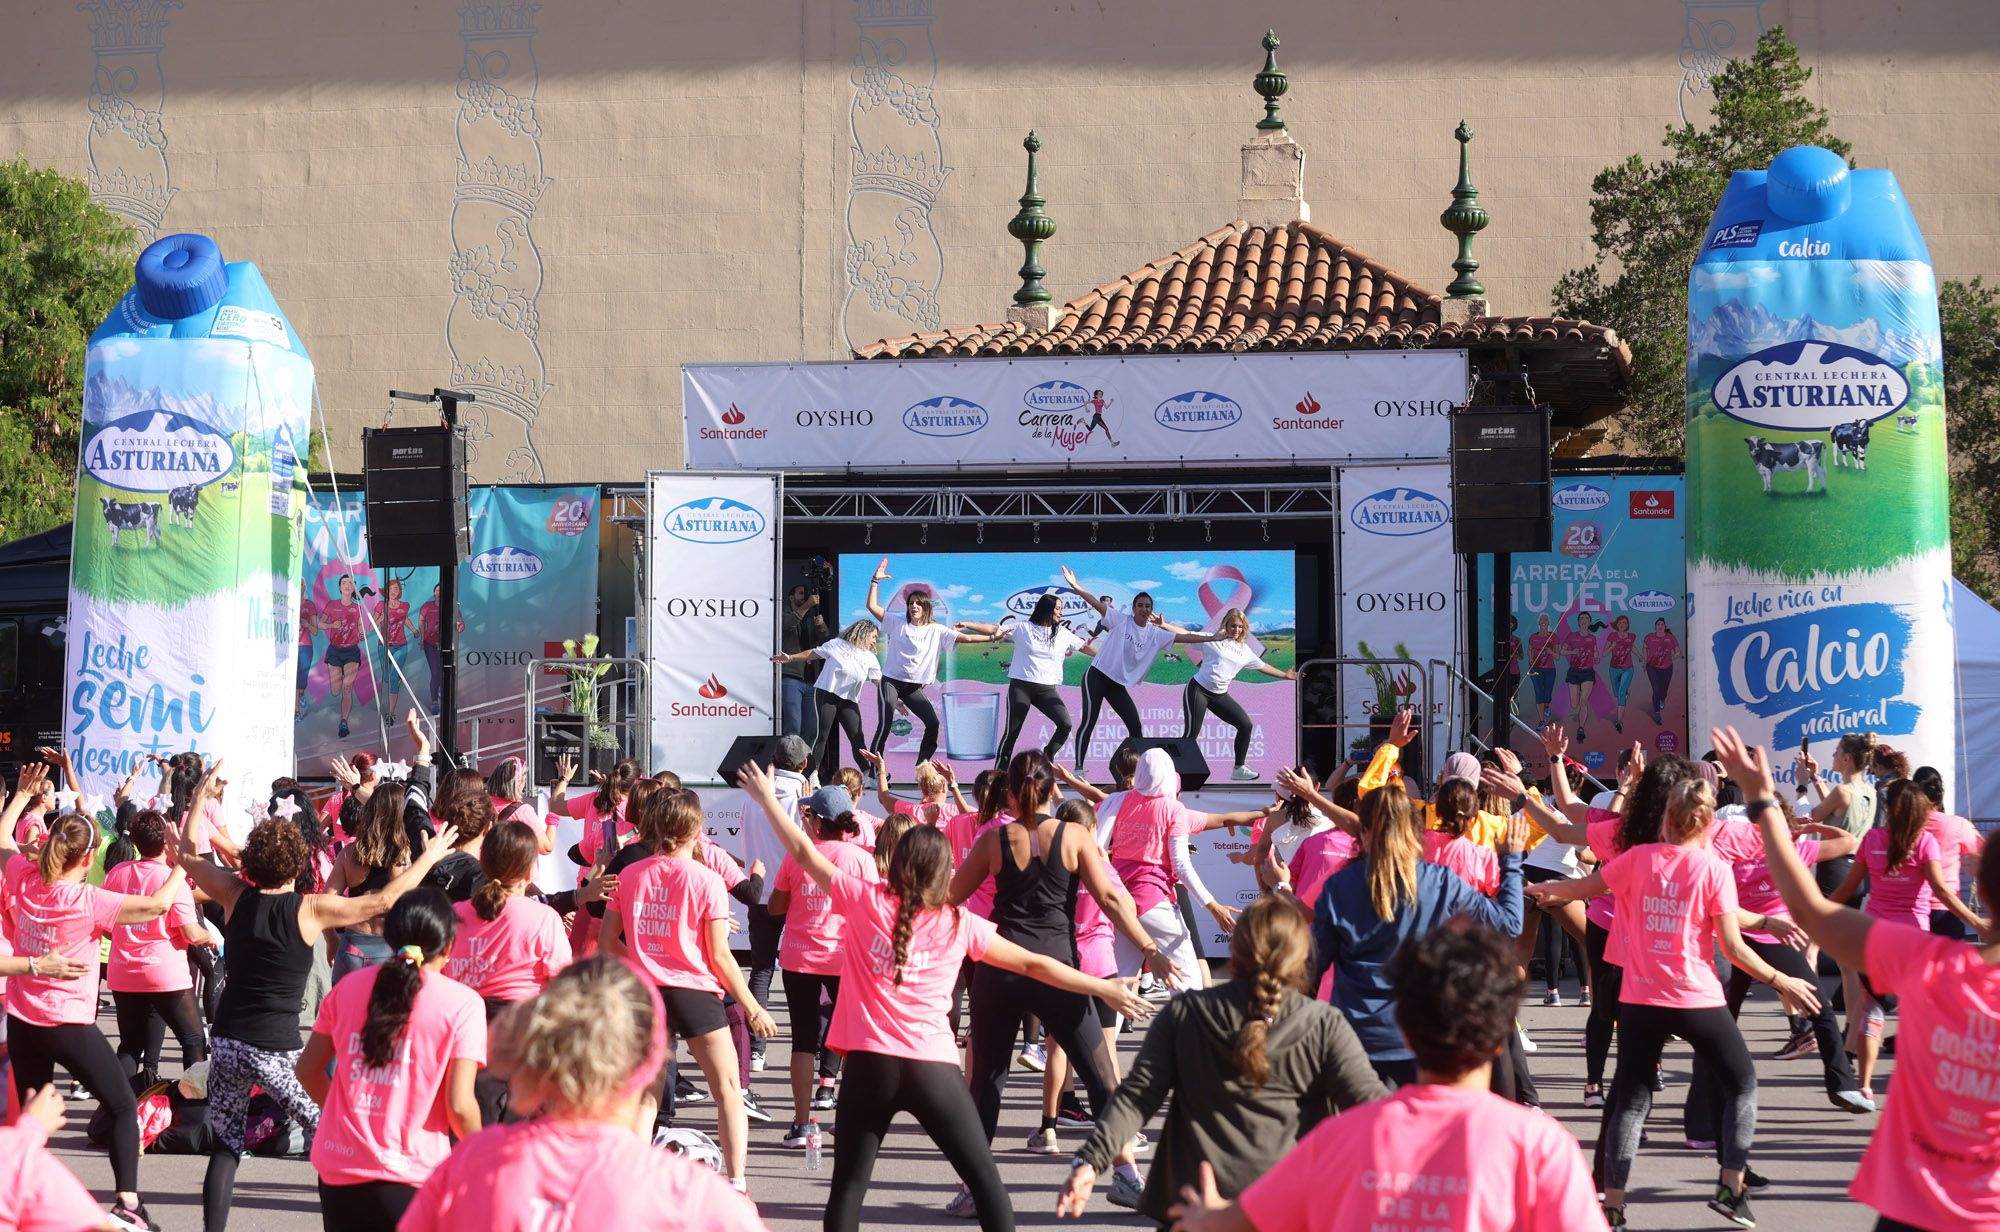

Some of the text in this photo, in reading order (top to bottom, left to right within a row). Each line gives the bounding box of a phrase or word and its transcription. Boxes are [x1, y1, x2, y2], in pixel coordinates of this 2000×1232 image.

[1713, 225, 1739, 243] PLS
[1778, 238, 1831, 257] Calcio
[1755, 371, 1888, 381] CENTRAL LECHERA
[1029, 392, 1085, 404] ASTURIANA
[1725, 374, 1895, 410] ASTURIANA
[1018, 409, 1073, 426] Carrera
[1161, 406, 1236, 422] ASTURIANA
[1374, 399, 1454, 418] OYSHO
[796, 409, 874, 428] OYSHO
[910, 411, 983, 427] ASTURIANA
[1272, 417, 1345, 430] Santander
[700, 427, 769, 440] Santander
[1031, 424, 1094, 451] de la Mujer
[113, 438, 218, 448] CENTRAL LECHERA
[89, 438, 222, 473] ASTURIANA
[1556, 494, 1606, 505] ASTURIANA
[1359, 505, 1443, 525] ASTURIANA
[1633, 508, 1671, 516] Santander
[672, 513, 758, 532] ASTURIANA
[475, 558, 539, 573] ASTURIANA
[1513, 564, 1640, 581] ARRERA DE LA
[667, 598, 760, 618] OYSHO
[1013, 597, 1089, 610] ASTANA
[1356, 591, 1446, 612] OYSHO
[1631, 598, 1674, 608] ASTURIANA
[1723, 586, 1842, 625] Leche rica en
[76, 630, 152, 681] Leche
[466, 650, 534, 666] OYSHO
[1730, 623, 1890, 705] Calcio
[71, 673, 217, 735] semi
[671, 701, 755, 718] Santander
[1800, 698, 1888, 737] natural
[1213, 842, 1250, 850] TotalEne
[652, 886, 669, 903] TU
[633, 901, 678, 921] DORSAL
[638, 919, 672, 938] SUMA
[1645, 914, 1685, 934] SUMA
[647, 942, 664, 953] 2024
[1378, 1196, 1452, 1221] DE LA
